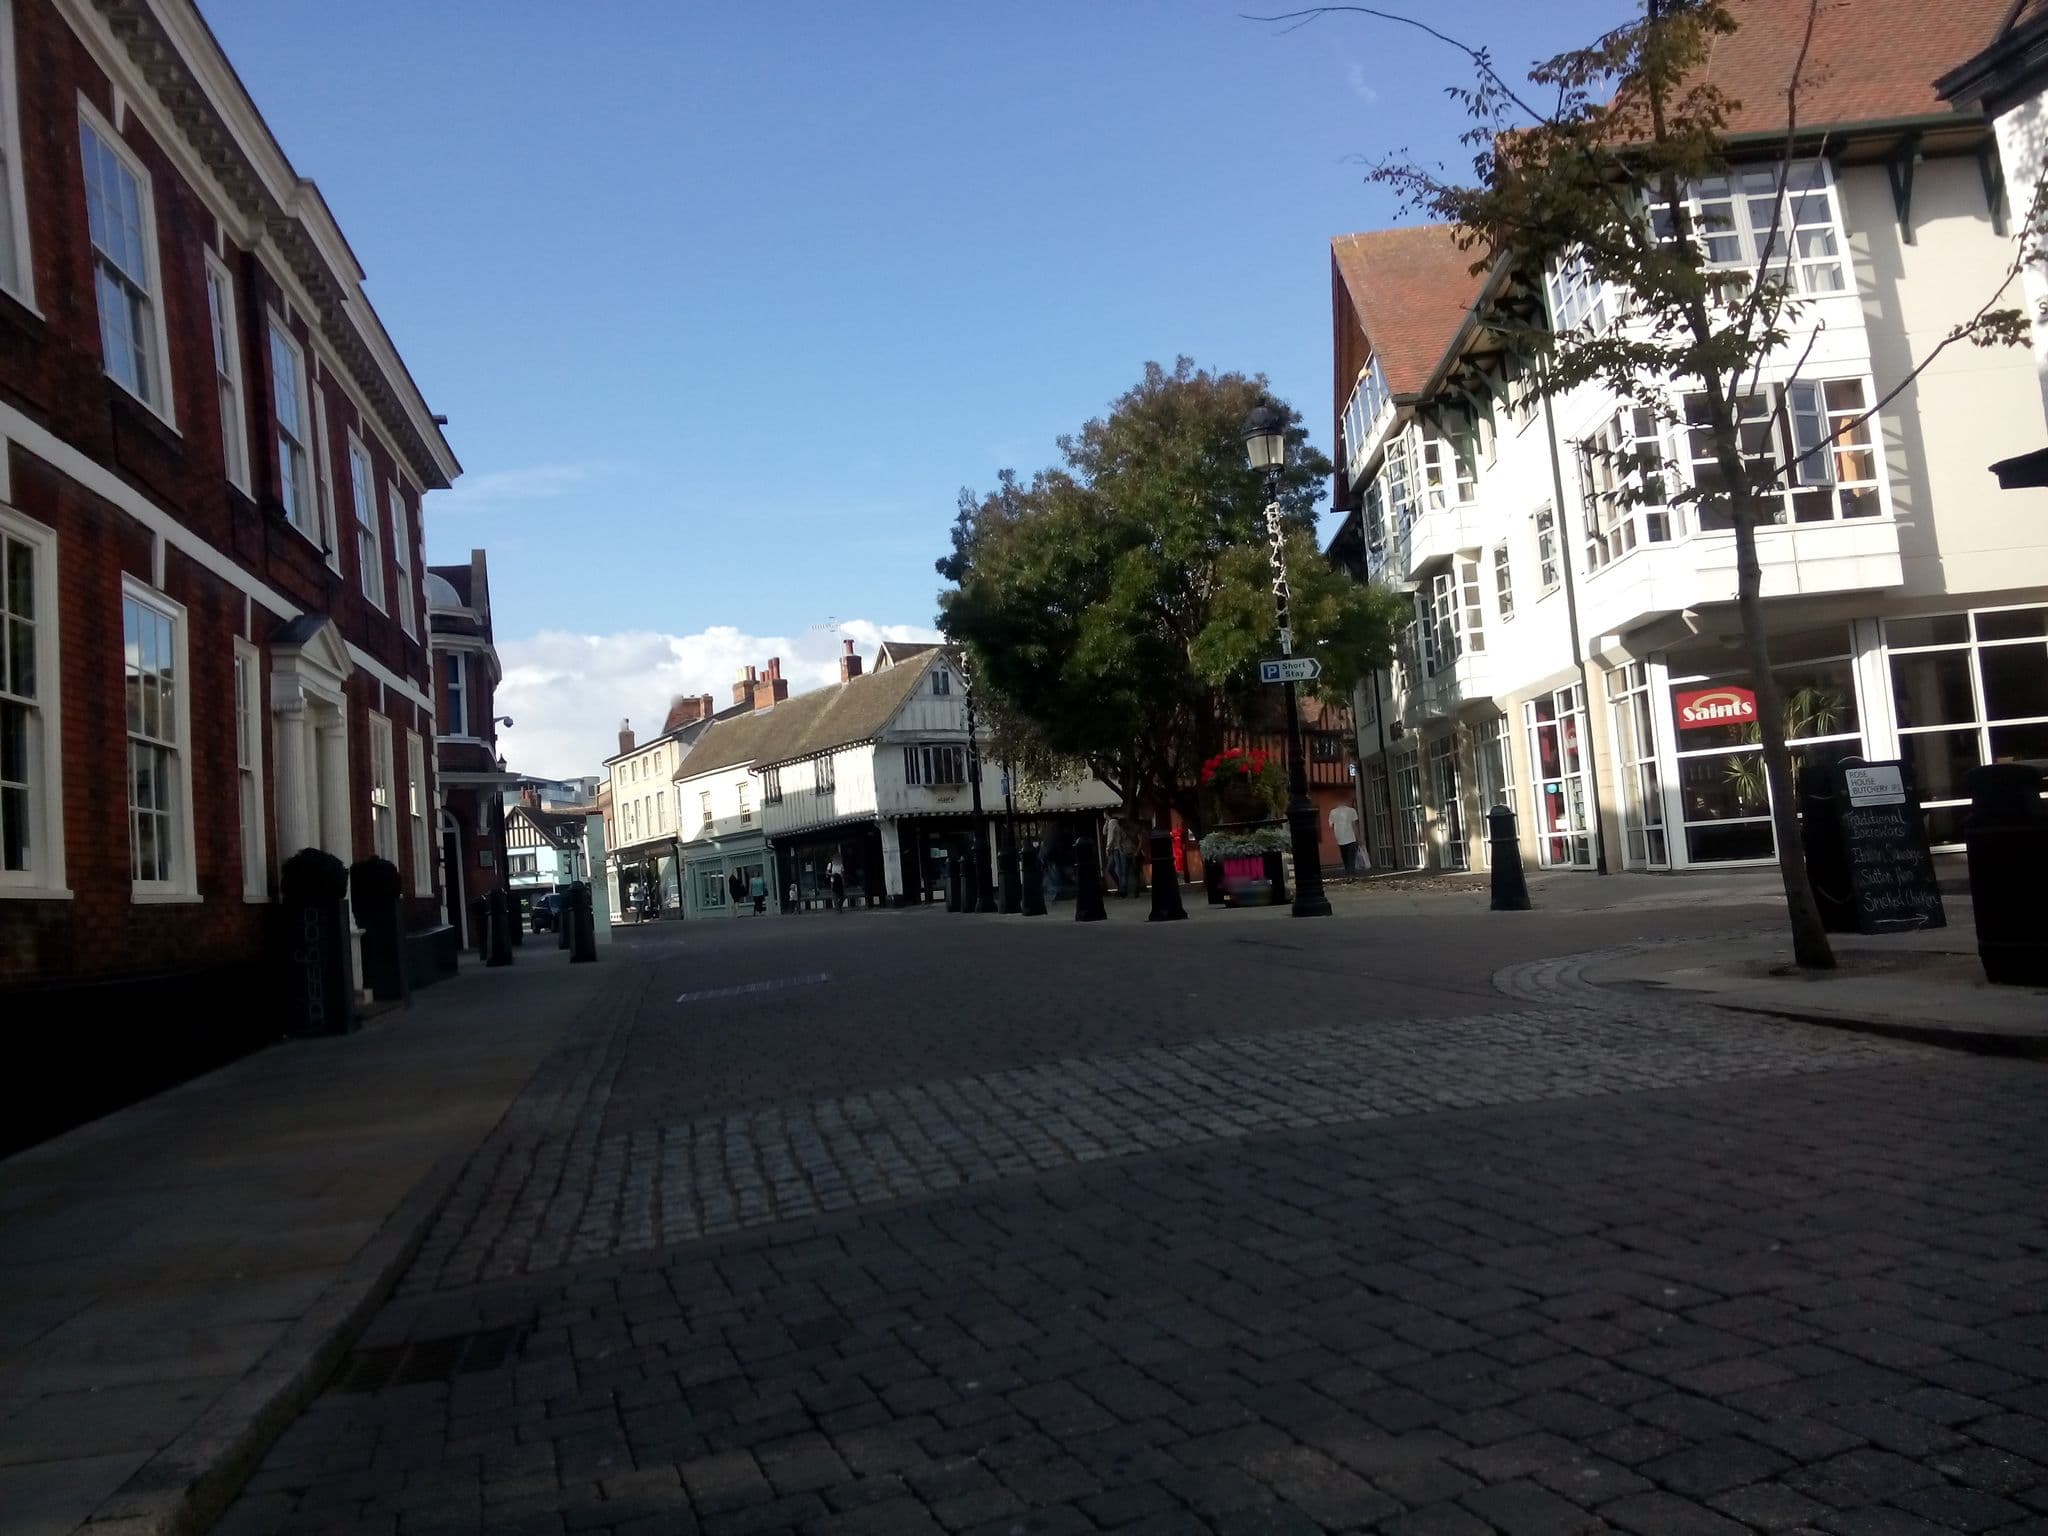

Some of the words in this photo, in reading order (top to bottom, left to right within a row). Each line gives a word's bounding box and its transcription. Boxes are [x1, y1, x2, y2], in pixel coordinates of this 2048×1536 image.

[1285, 670, 1304, 678] Stay
[1682, 701, 1753, 722] Saints
[1849, 770, 1868, 778] ROSE
[1851, 778, 1876, 786] HOUSE
[1852, 785, 1888, 794] BUTCHERY
[1847, 808, 1906, 826] Traditional
[1861, 869, 1893, 885] Sutton
[1863, 892, 1905, 912] Smoked
[1905, 889, 1940, 910] Chicken
